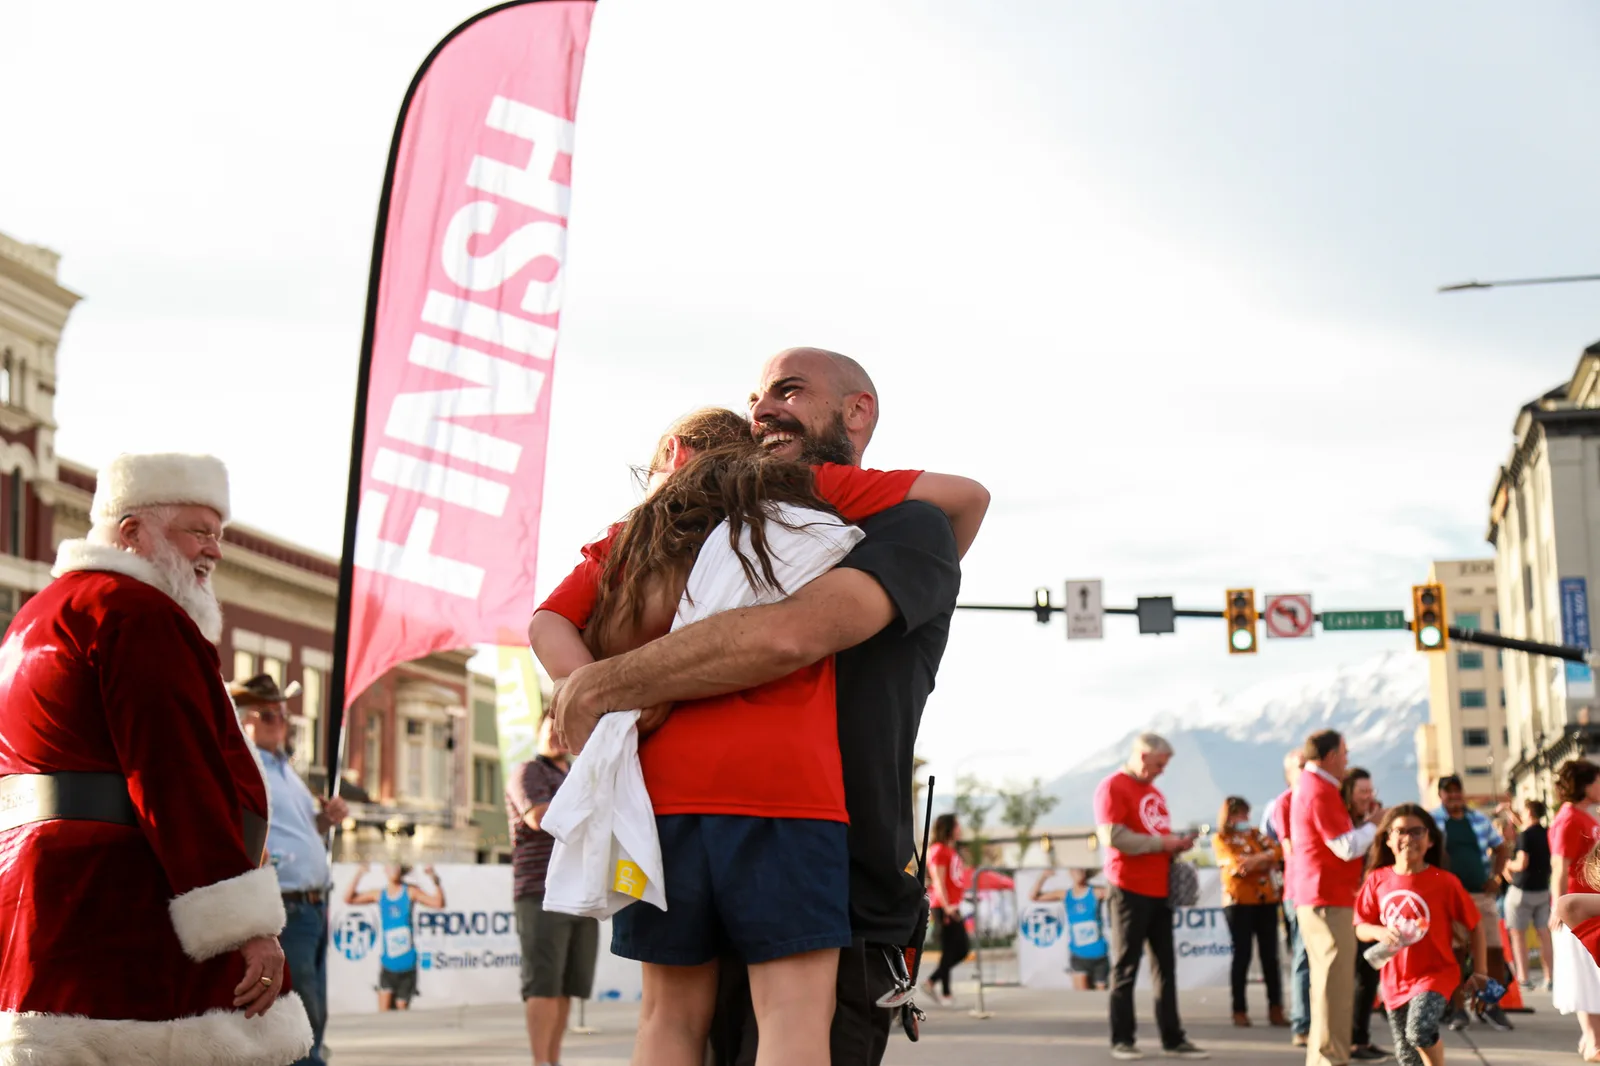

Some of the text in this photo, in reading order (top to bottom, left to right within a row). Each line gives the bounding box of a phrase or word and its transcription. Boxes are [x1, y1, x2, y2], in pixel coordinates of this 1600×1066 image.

[353, 95, 575, 600] FINISH
[418, 911, 488, 935] PROVO
[1186, 907, 1224, 929] CIT
